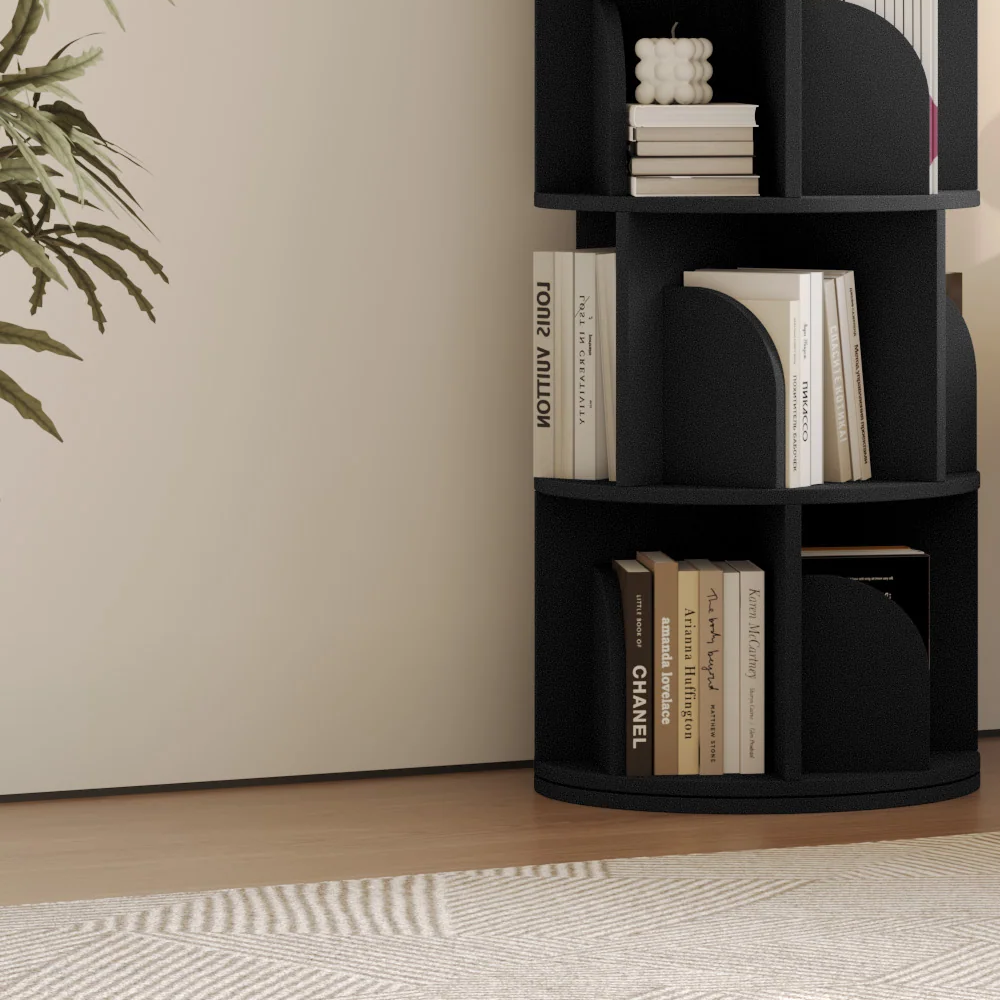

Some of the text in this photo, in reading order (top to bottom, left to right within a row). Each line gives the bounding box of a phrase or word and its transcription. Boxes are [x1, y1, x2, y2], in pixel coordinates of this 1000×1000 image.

[831, 325, 844, 383] СПАСИТЕ
[636, 639, 642, 648] OF
[661, 616, 672, 726] amanda lovelace
[680, 608, 696, 740] Arianna Huffington
[701, 588, 722, 691] The body beyond
[744, 588, 760, 680] Karen McCartney
[632, 664, 647, 750] CHANEL
